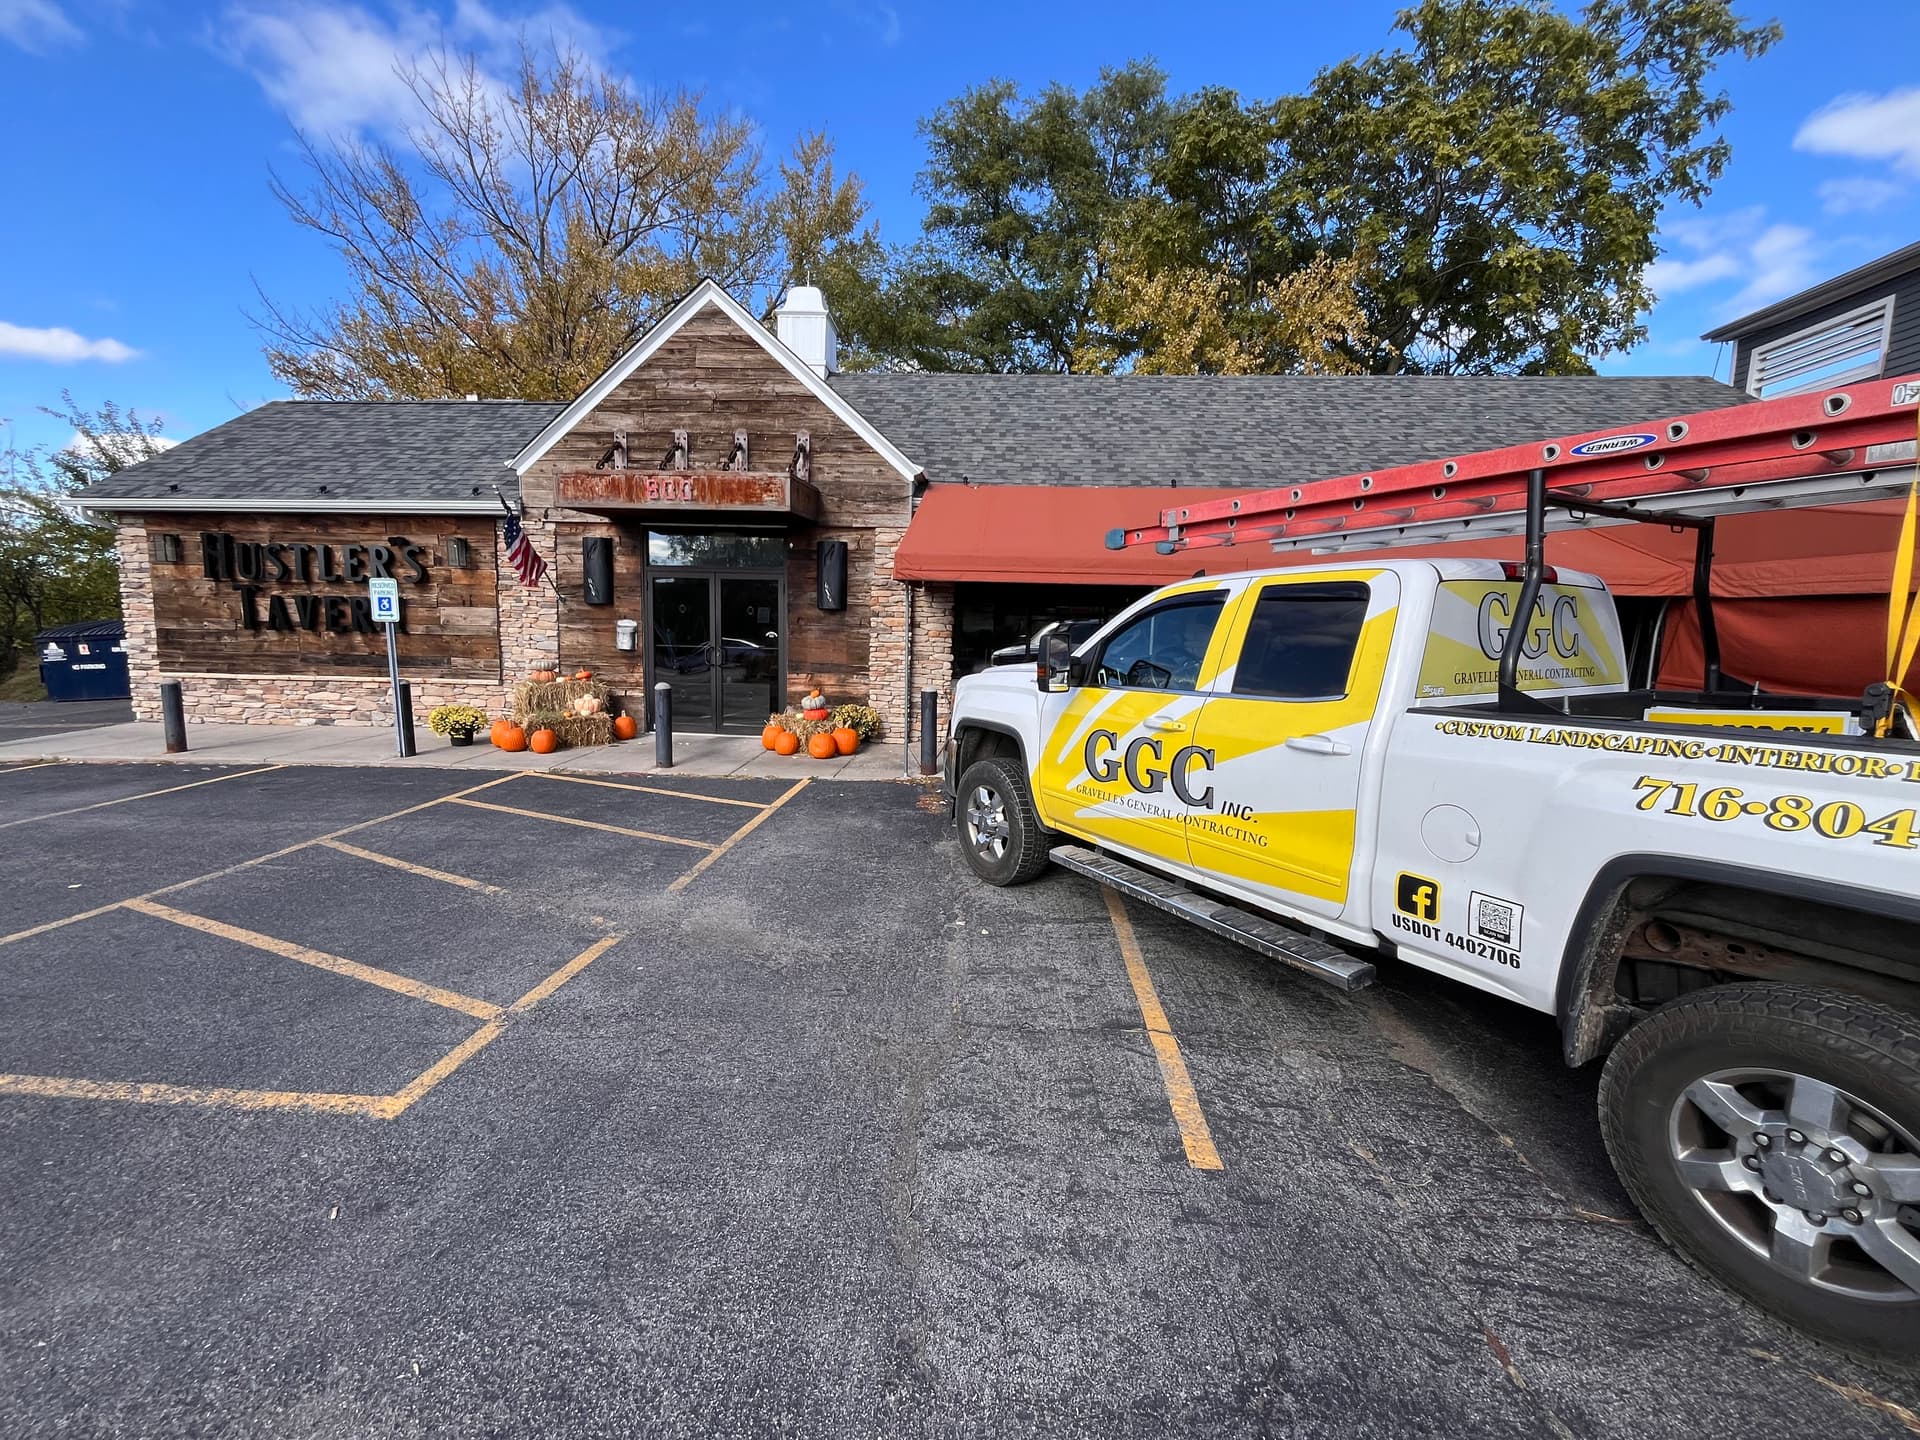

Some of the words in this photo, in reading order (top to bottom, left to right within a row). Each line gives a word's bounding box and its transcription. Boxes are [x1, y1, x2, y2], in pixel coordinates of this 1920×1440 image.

[1586, 438, 1639, 453] WERNER
[201, 532, 432, 584] HUSTLER'S
[232, 583, 409, 633] TAVER
[1477, 591, 1580, 661] GGC
[1544, 667, 1595, 681] CONTRACTING
[1084, 729, 1216, 810] GGC
[1220, 801, 1259, 824] INC.
[1076, 784, 1125, 806] GRAVELLE'S
[1127, 797, 1173, 820] GENERAL
[1176, 812, 1268, 847] CONTRACTING
[1392, 913, 1441, 941] USDOT
[1445, 932, 1521, 969] 4402706
